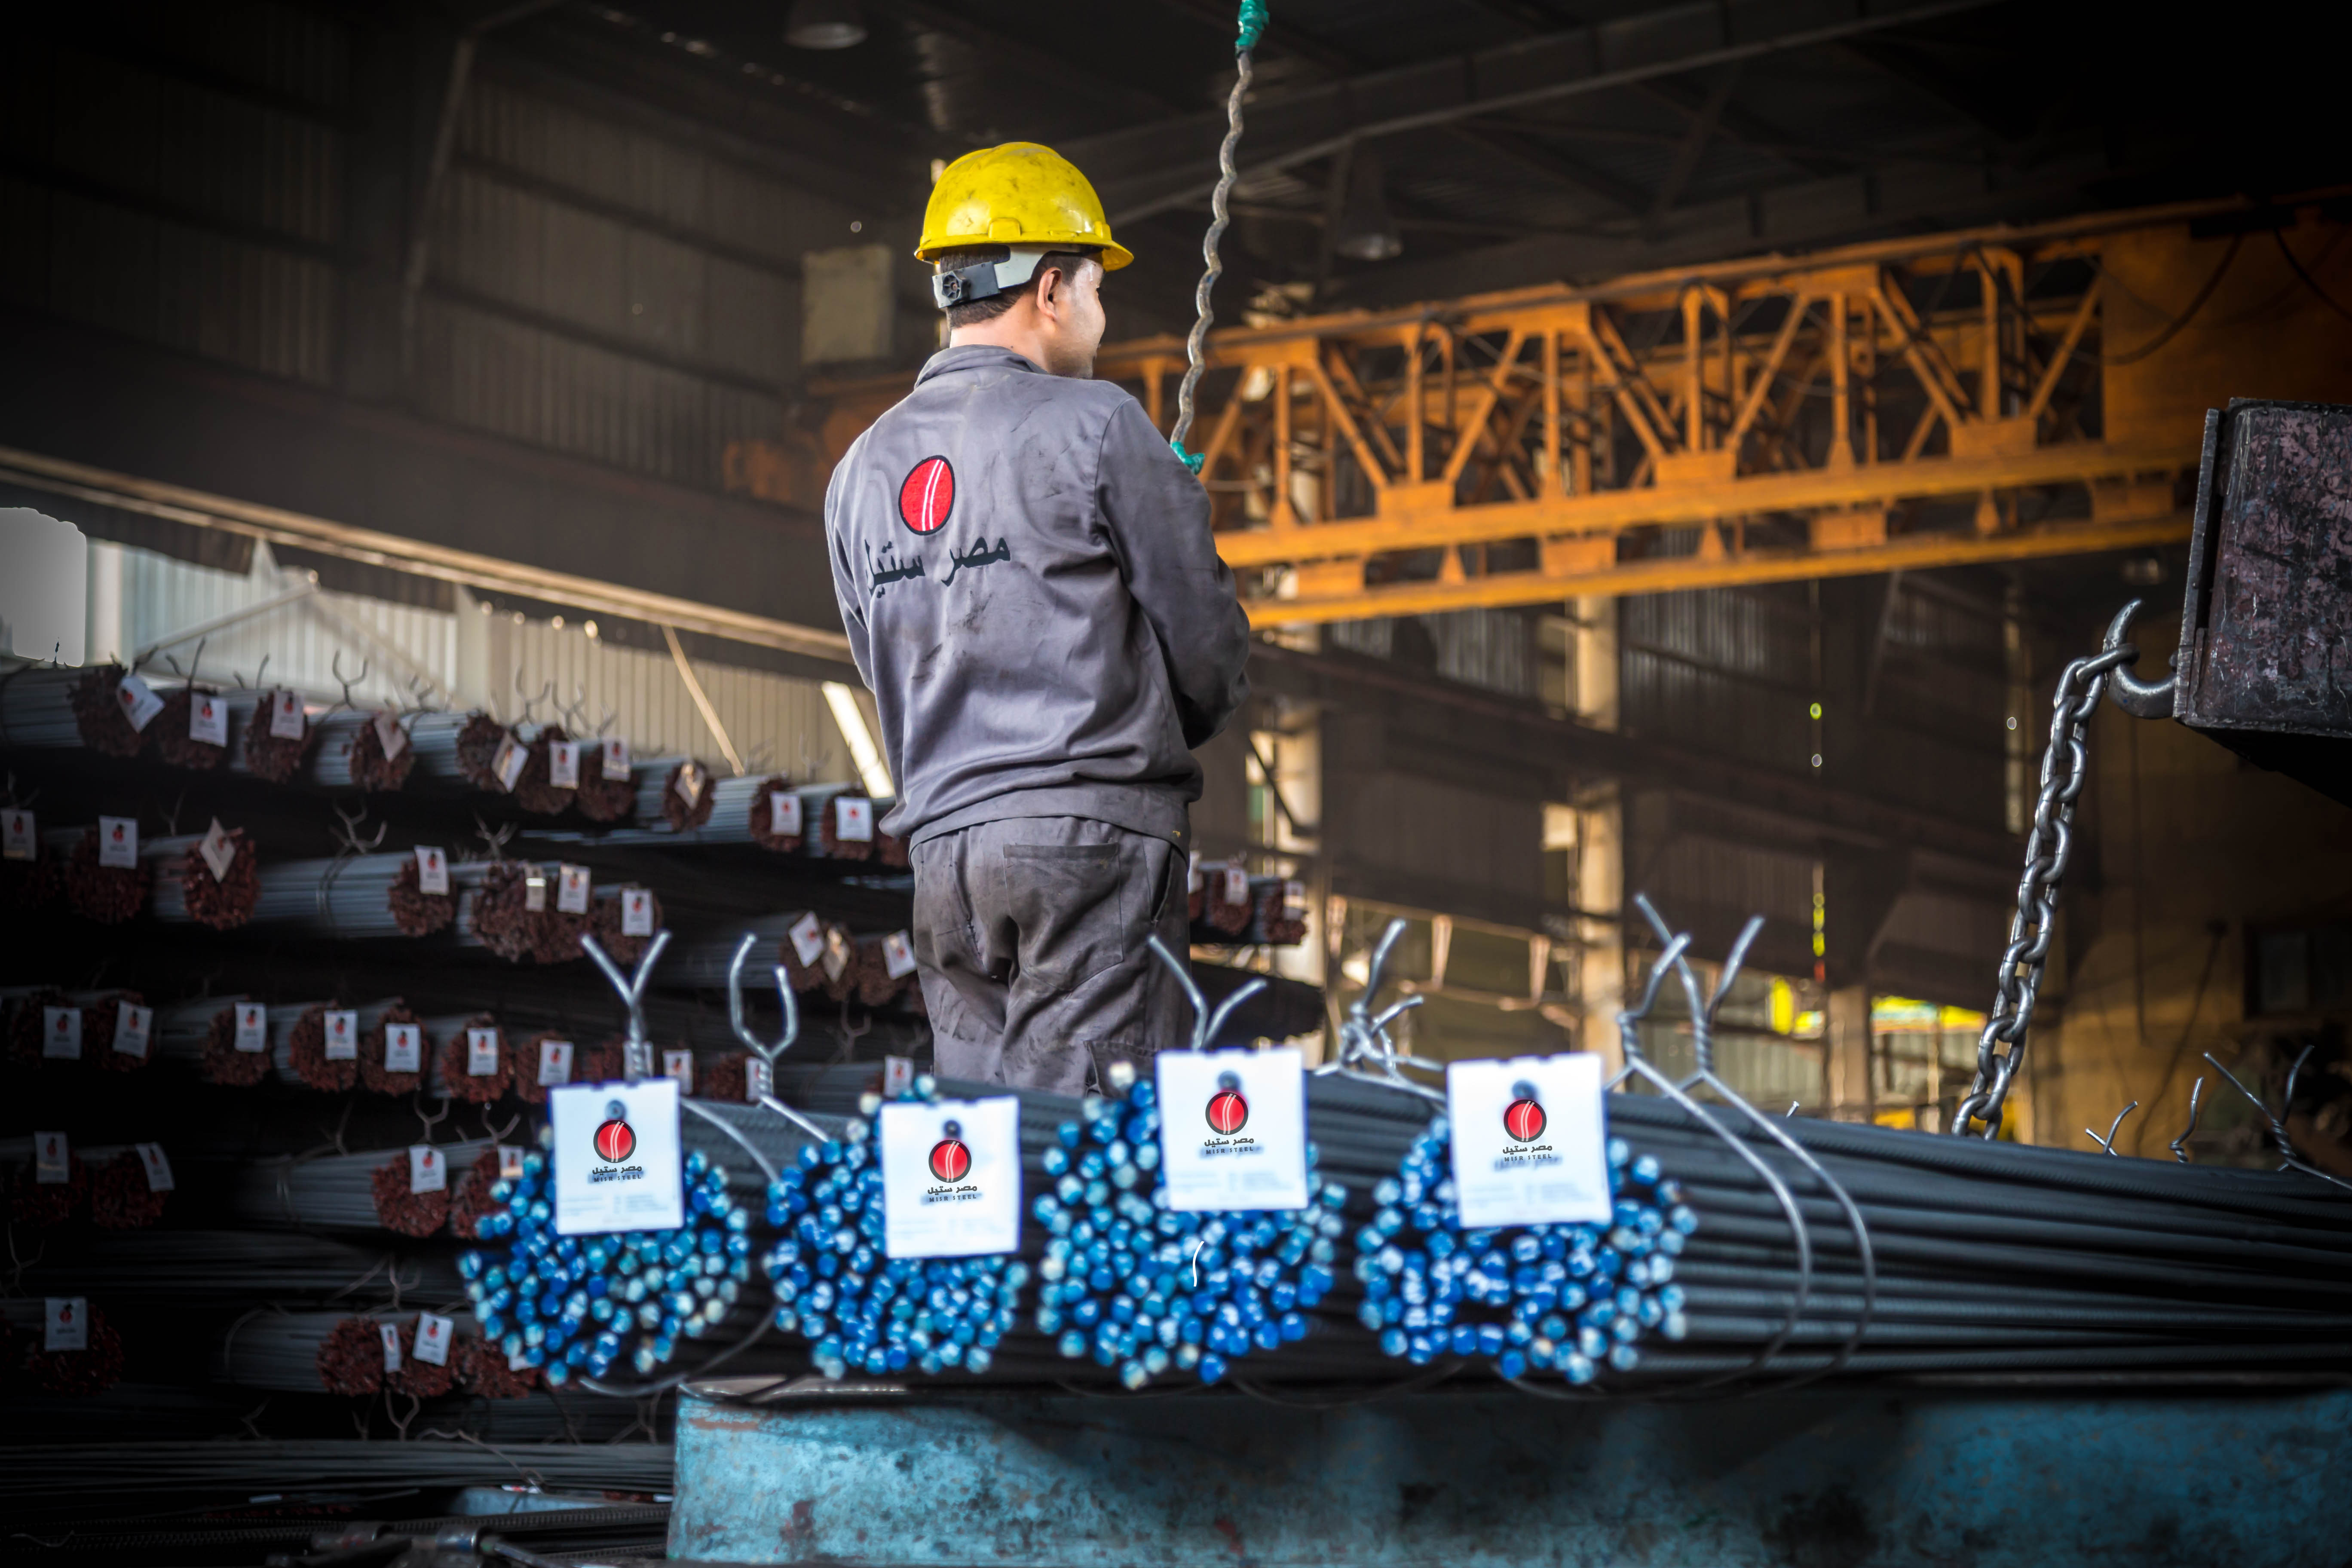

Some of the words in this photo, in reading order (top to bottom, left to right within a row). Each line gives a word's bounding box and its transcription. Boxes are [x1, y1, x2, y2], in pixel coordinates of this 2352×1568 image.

[941, 537, 1011, 587] مصر
[864, 539, 925, 598] ستيل
[1204, 1138, 1229, 1148] ستيل
[1503, 1145, 1528, 1155] ستيل
[592, 1166, 617, 1176] ستيل
[928, 1186, 952, 1195] ستيل
